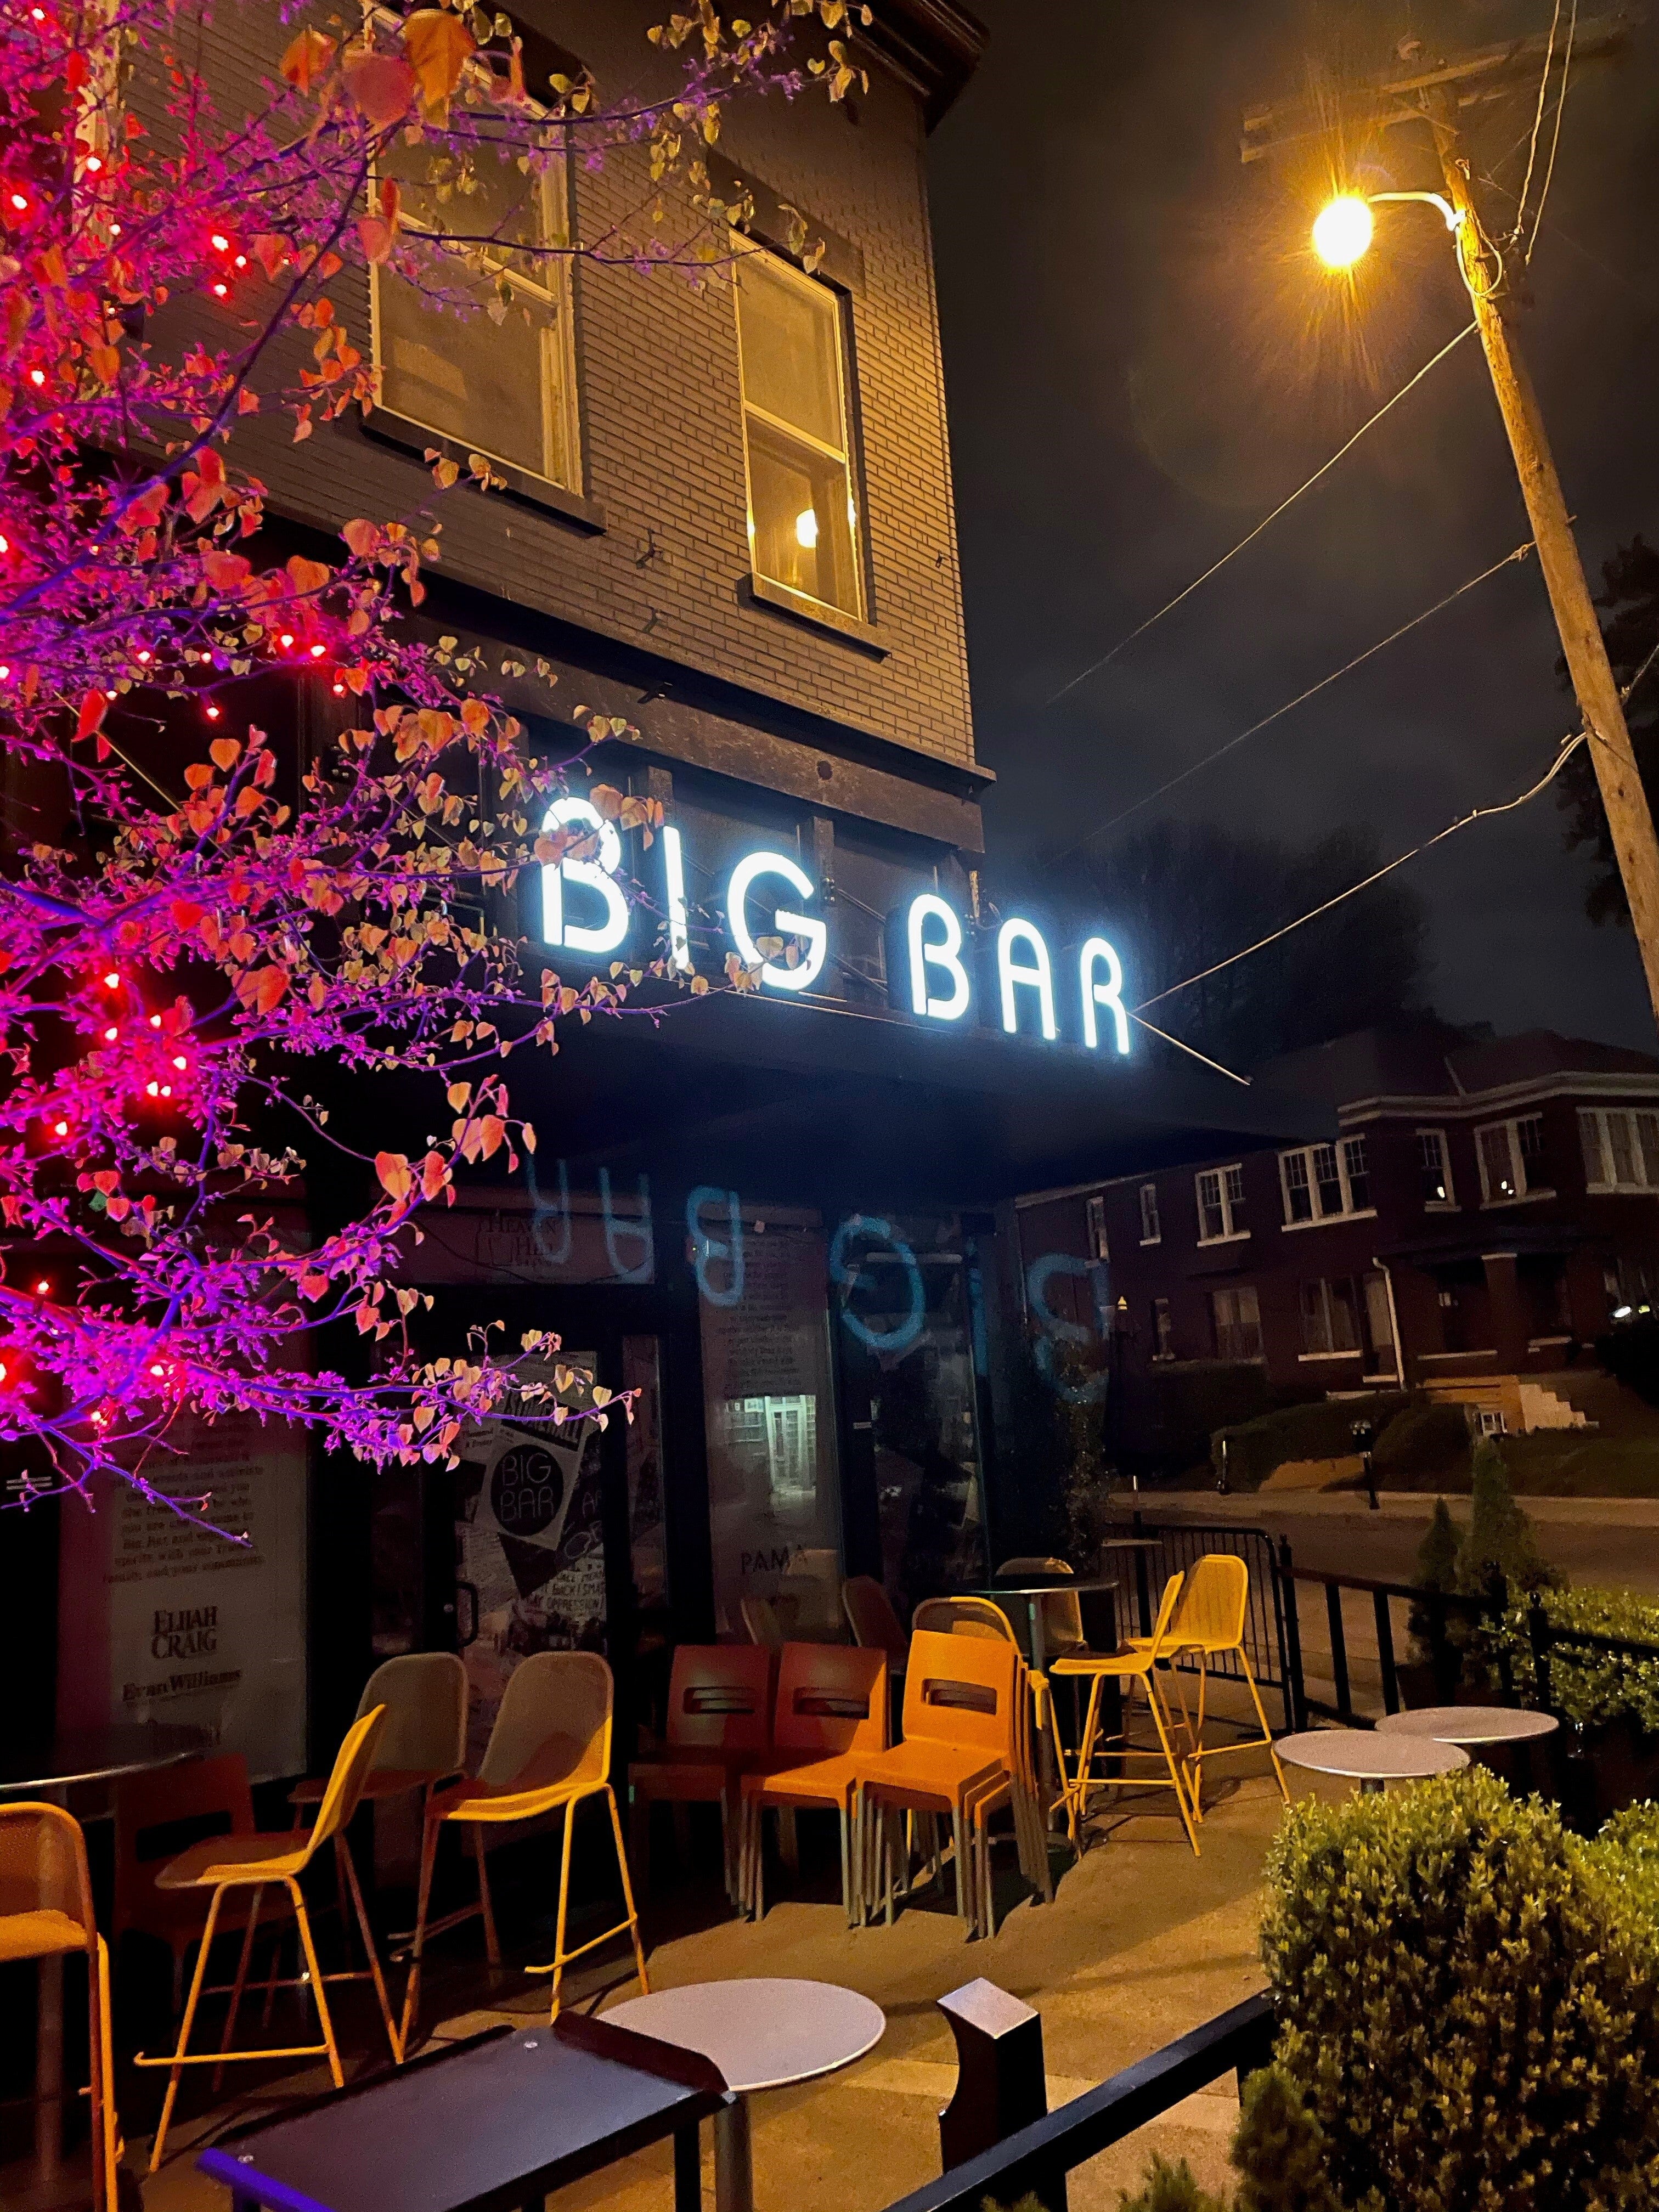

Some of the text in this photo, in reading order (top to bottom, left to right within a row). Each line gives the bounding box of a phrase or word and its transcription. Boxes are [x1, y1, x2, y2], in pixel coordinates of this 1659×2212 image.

[542, 797, 1130, 1054] BIG BAR
[501, 1452, 551, 1486] BIG
[500, 1485, 554, 1522] BAR
[154, 1606, 218, 1634] ELIJAH
[151, 1628, 217, 1659] CRAIG
[170, 1669, 241, 1691] Williams
